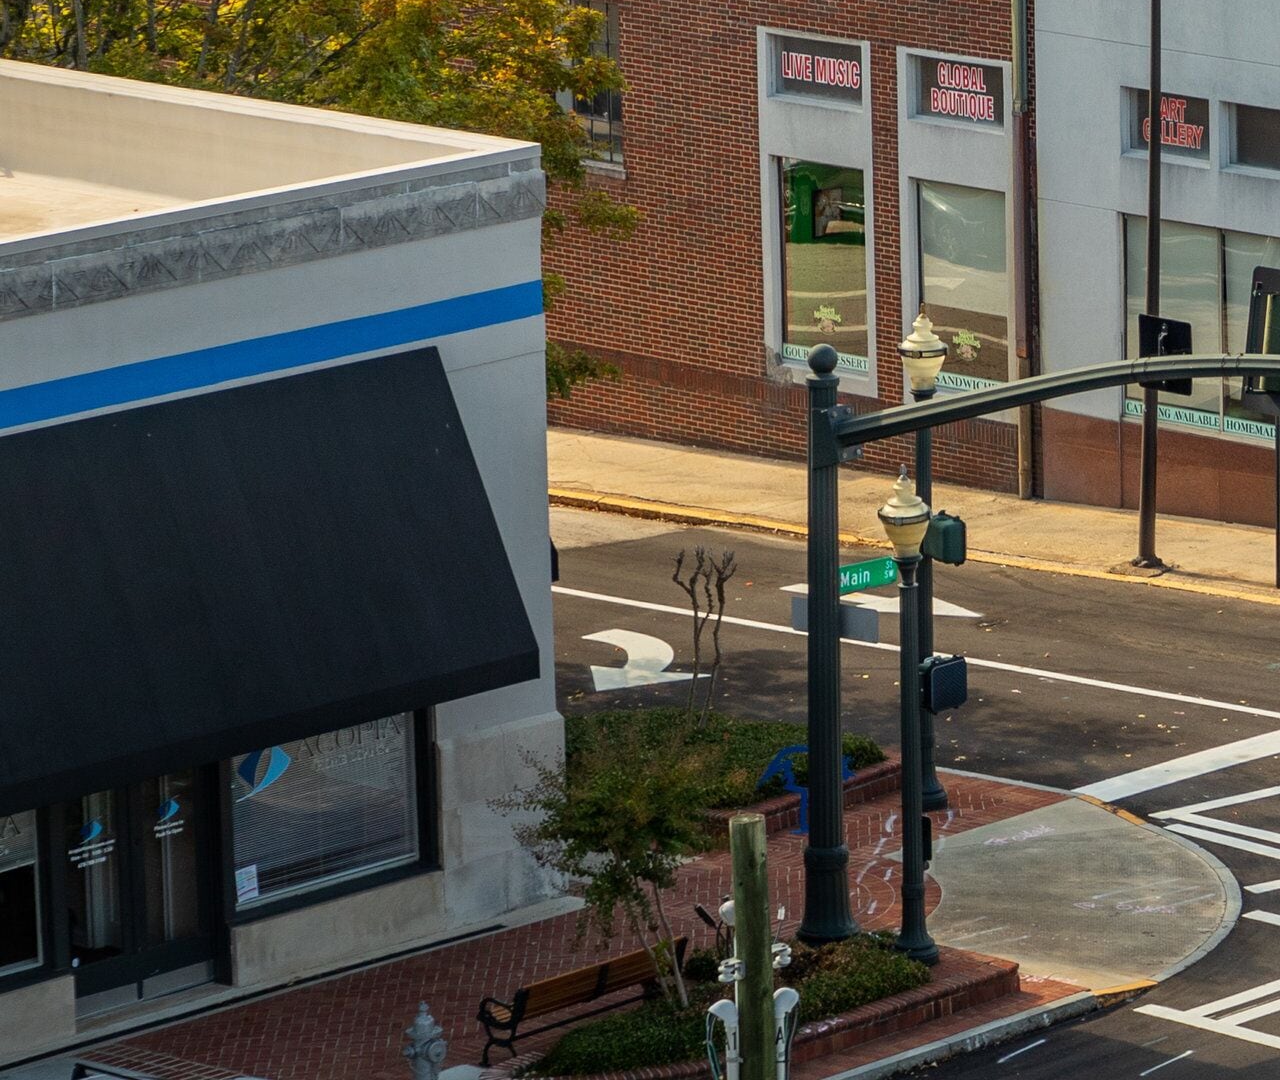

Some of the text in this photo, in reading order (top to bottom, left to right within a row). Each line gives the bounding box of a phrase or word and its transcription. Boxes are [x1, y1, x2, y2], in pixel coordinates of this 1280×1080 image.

[781, 50, 861, 89] LIVE MUSIC
[937, 62, 987, 92] GLOBAL
[930, 87, 994, 122] BOUTIQUE
[1160, 96, 1187, 123] ART
[1142, 117, 1204, 149] GLLERY
[836, 356, 869, 370] ESSERT
[1173, 408, 1220, 426] AVAILABLE
[884, 569, 895, 580] SW
[885, 560, 893, 570] St
[840, 569, 871, 589] Main
